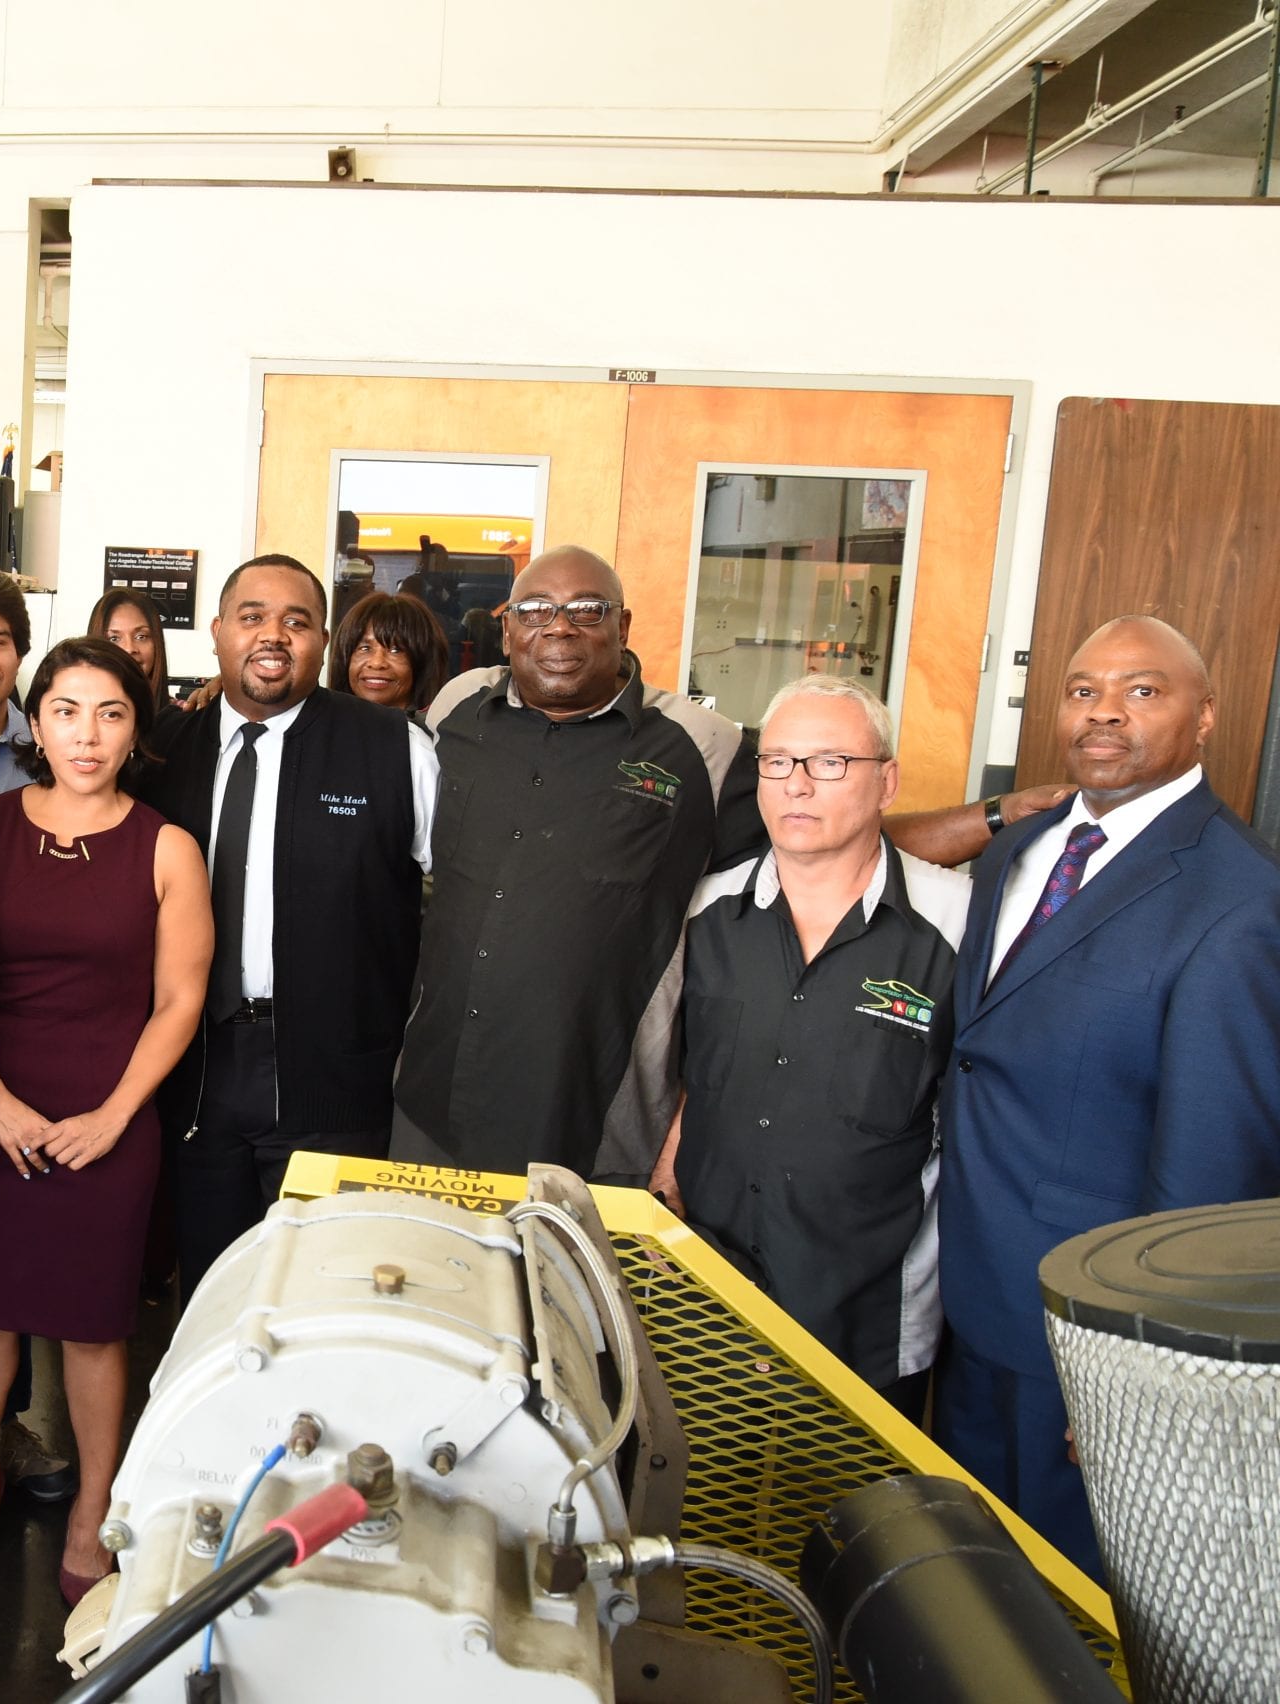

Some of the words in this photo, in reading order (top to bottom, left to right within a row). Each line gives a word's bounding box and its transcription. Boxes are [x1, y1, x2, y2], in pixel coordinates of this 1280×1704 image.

[616, 370, 648, 381] F-100G
[319, 793, 340, 803] Mike
[343, 795, 367, 805] Mach
[328, 806, 357, 816] 76503
[376, 1172, 494, 1194] MOVING
[198, 1470, 238, 1486] RELAY
